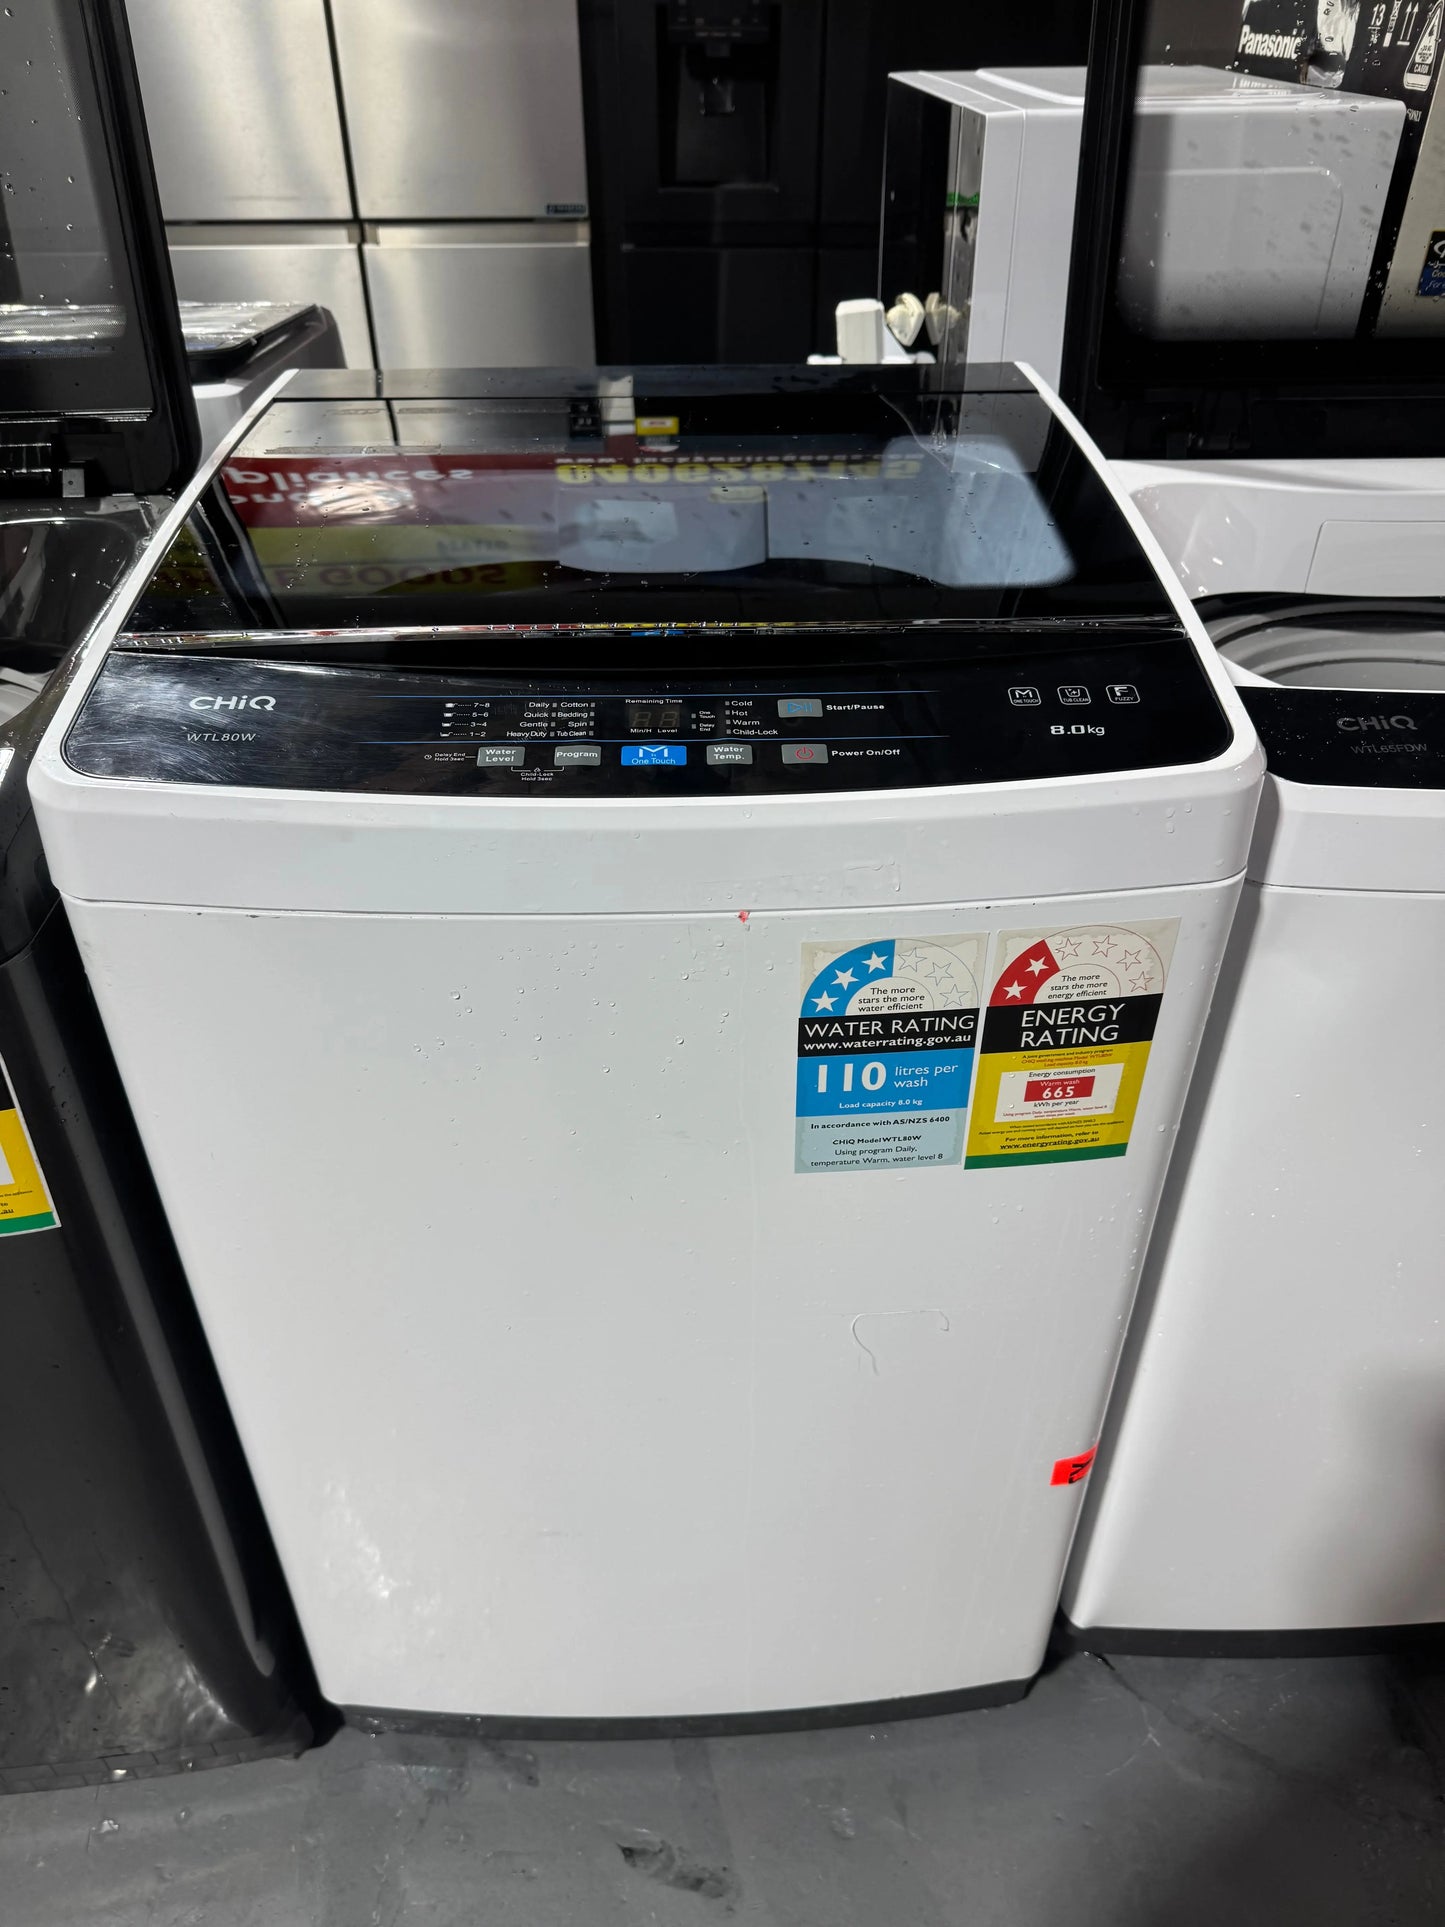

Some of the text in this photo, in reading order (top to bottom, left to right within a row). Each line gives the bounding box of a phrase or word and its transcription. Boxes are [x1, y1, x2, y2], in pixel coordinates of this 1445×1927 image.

[1238, 24, 1301, 60] Panasonic
[189, 694, 277, 711] CHiQ
[826, 703, 885, 711] Start/Pause
[524, 711, 549, 719] Quick
[558, 711, 588, 719] Bedding
[1336, 715, 1418, 731] CHiQ
[506, 730, 547, 738] Heavy Duty
[732, 728, 778, 736] Child-Lock
[187, 733, 256, 742] WTL80W
[714, 746, 744, 754] Water
[556, 751, 598, 760] Program
[714, 753, 745, 761] Temp.
[1050, 984, 1070, 992] stars
[1047, 989, 1107, 1001] energy efficient
[887, 1002, 923, 1011] efficient
[1021, 1003, 1126, 1027] ENERGY
[804, 1015, 975, 1038] WATER RATING
[1020, 1025, 1119, 1048] RATING
[804, 1034, 971, 1050] www.waterrating.gov.au
[1053, 1067, 1096, 1076] consumption
[817, 1061, 959, 1093] 110 litres per
[893, 1077, 928, 1088] wash
[1042, 1086, 1075, 1099] 665
[862, 1100, 896, 1109] capacity
[912, 1099, 923, 1107] kg
[1064, 1099, 1079, 1107] year
[821, 1121, 871, 1129] accordance
[873, 1119, 892, 1127] with
[892, 1117, 928, 1125] AS/NZS
[882, 1134, 922, 1143] WTL80W
[1036, 1132, 1074, 1141] information,
[1000, 1137, 1100, 1150] www.energyrating.gov.au
[834, 1146, 918, 1157] Using program Daily,
[811, 1160, 860, 1168] temperature
[917, 1153, 936, 1161] level
